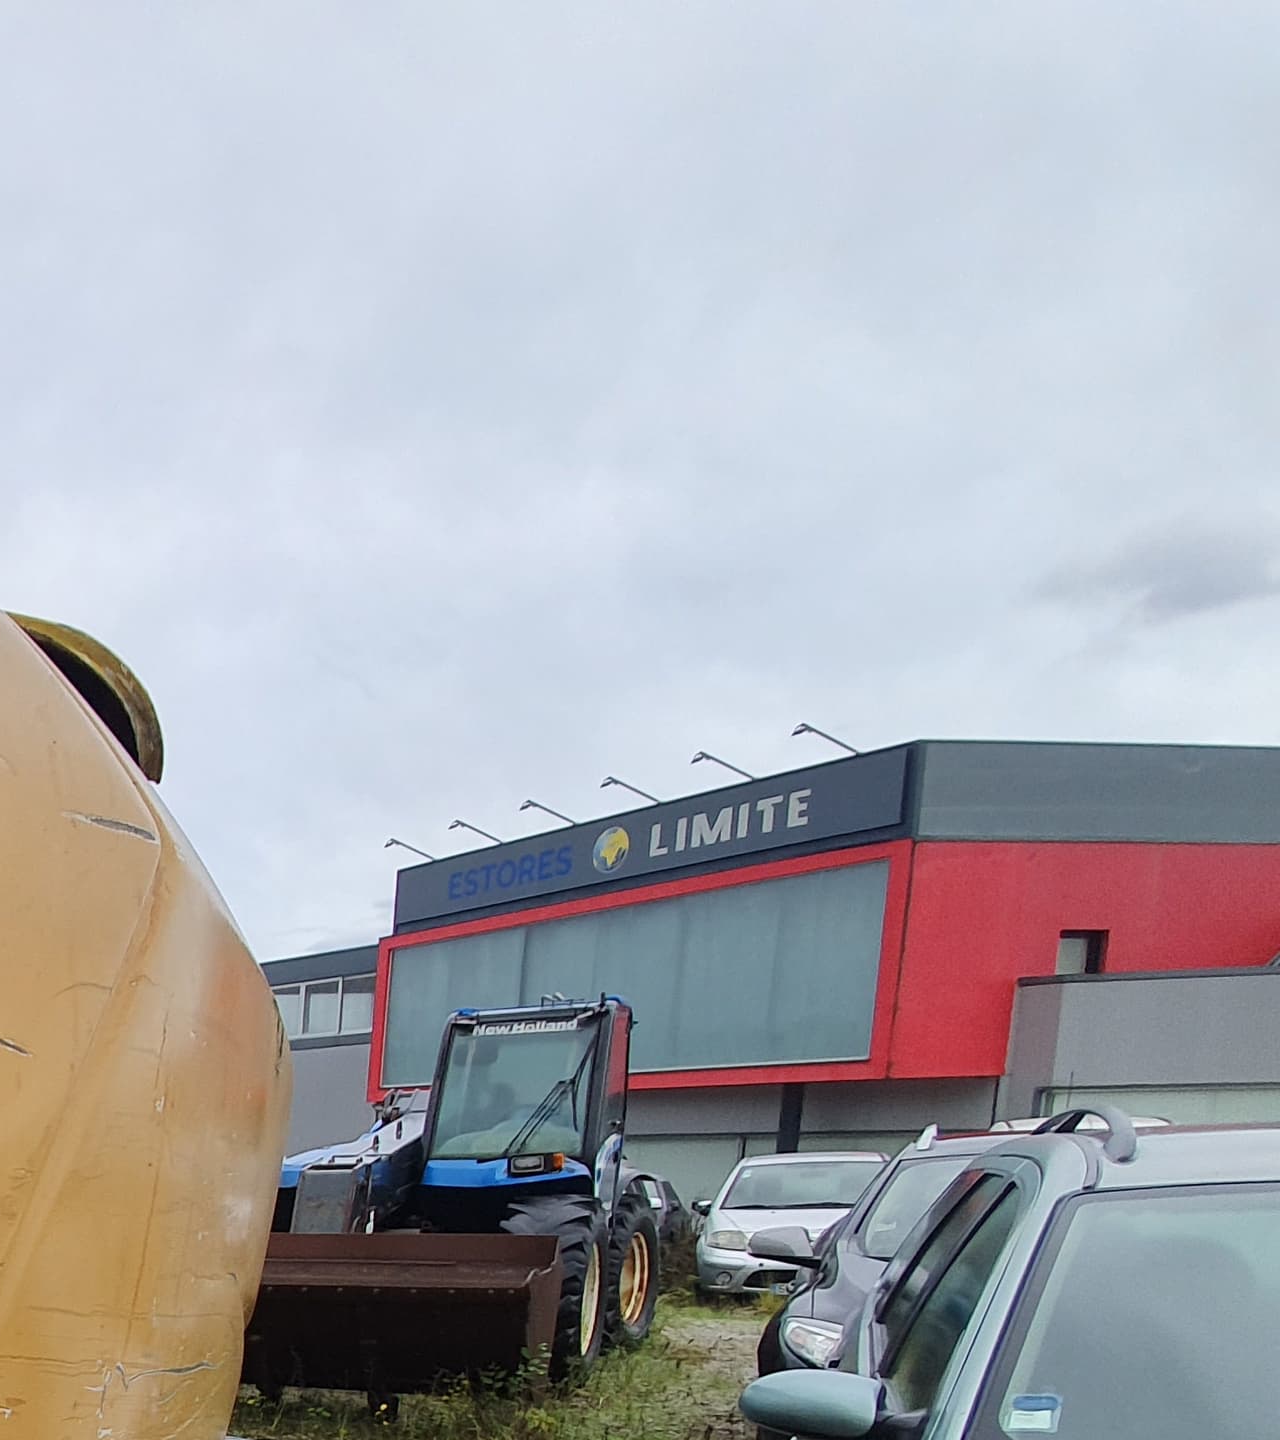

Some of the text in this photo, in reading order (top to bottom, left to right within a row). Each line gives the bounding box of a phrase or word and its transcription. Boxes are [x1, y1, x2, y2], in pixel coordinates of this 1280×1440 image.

[447, 788, 812, 899] ESTORES LIMITE
[472, 1019, 578, 1036] New Holland
